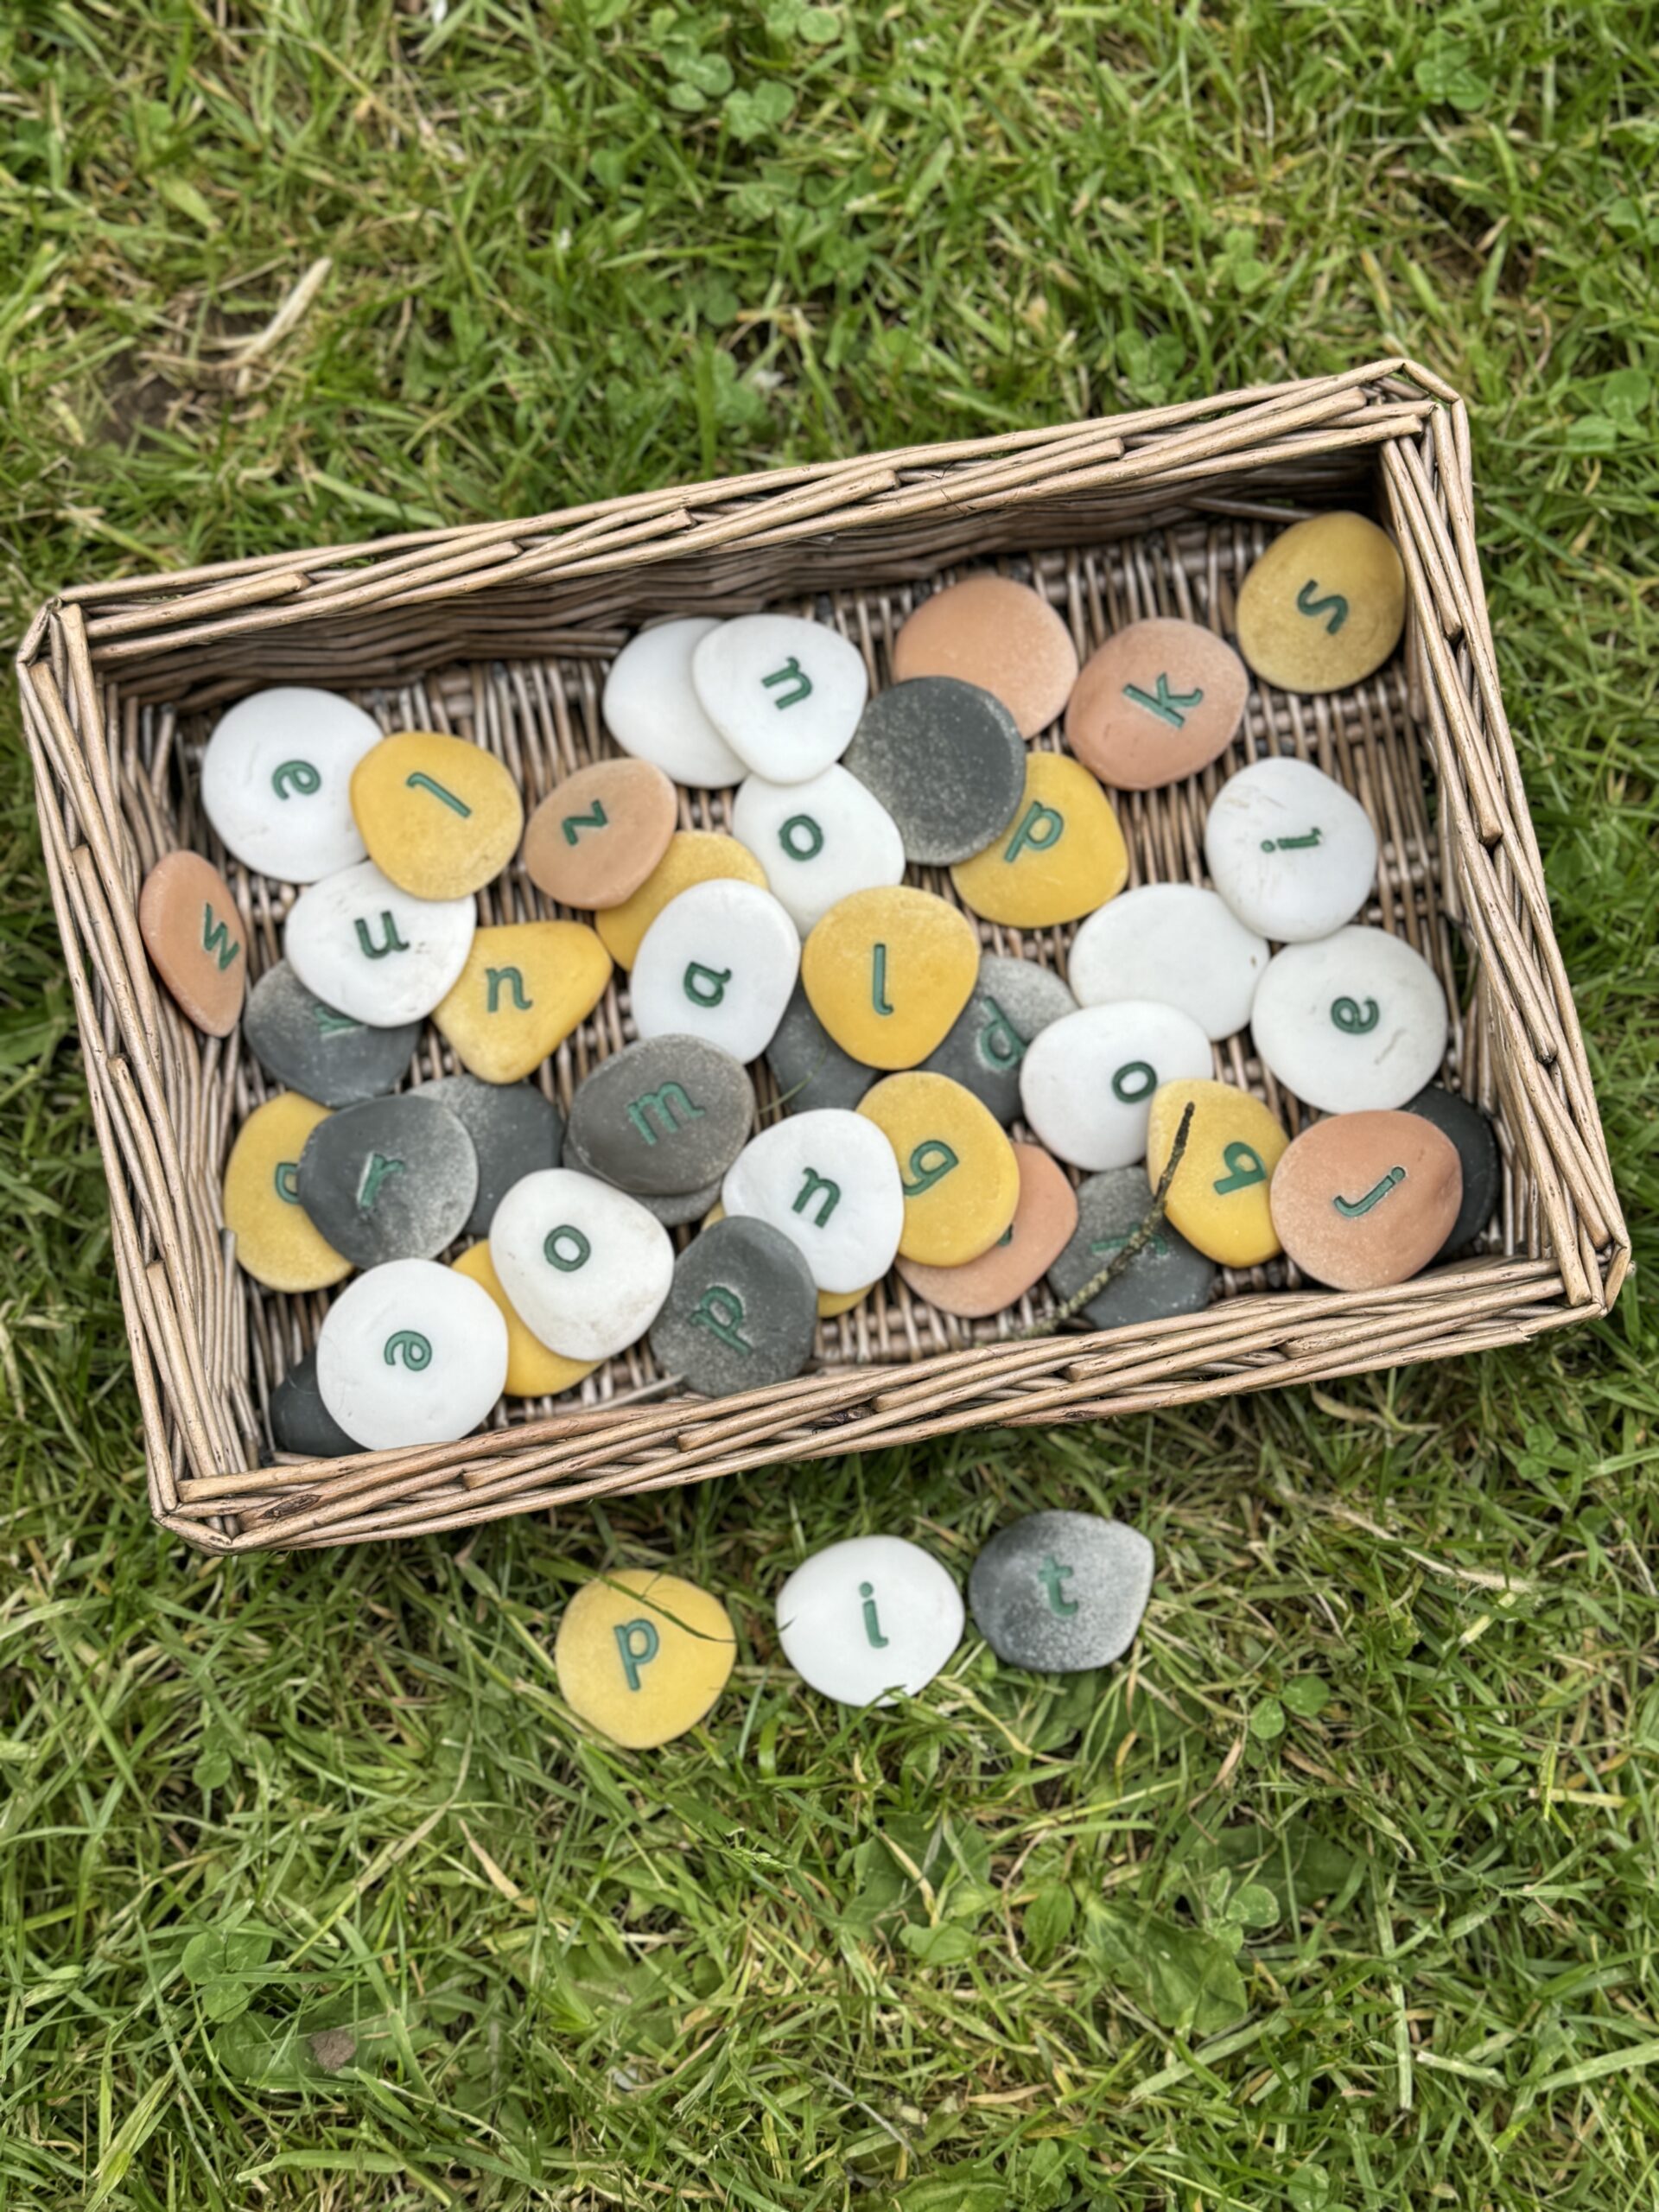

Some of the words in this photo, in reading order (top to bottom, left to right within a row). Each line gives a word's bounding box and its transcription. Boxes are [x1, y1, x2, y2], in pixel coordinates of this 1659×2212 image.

[1297, 579, 1349, 635] s
[1123, 672, 1204, 728] k
[272, 760, 321, 799] e
[406, 771, 471, 817] l
[779, 815, 823, 861] o
[1004, 801, 1064, 863] p
[1260, 827, 1322, 852] i
[354, 911, 409, 958] u
[486, 967, 532, 1012] n
[683, 961, 731, 1007] a
[872, 944, 893, 1015] l
[982, 995, 1027, 1070] d
[1331, 996, 1379, 1033] e
[1112, 1061, 1157, 1103] o
[628, 1082, 705, 1144] m
[357, 1153, 405, 1209] r
[1333, 1166, 1405, 1217] j
[544, 1224, 590, 1272] o
[385, 1331, 431, 1371] e
